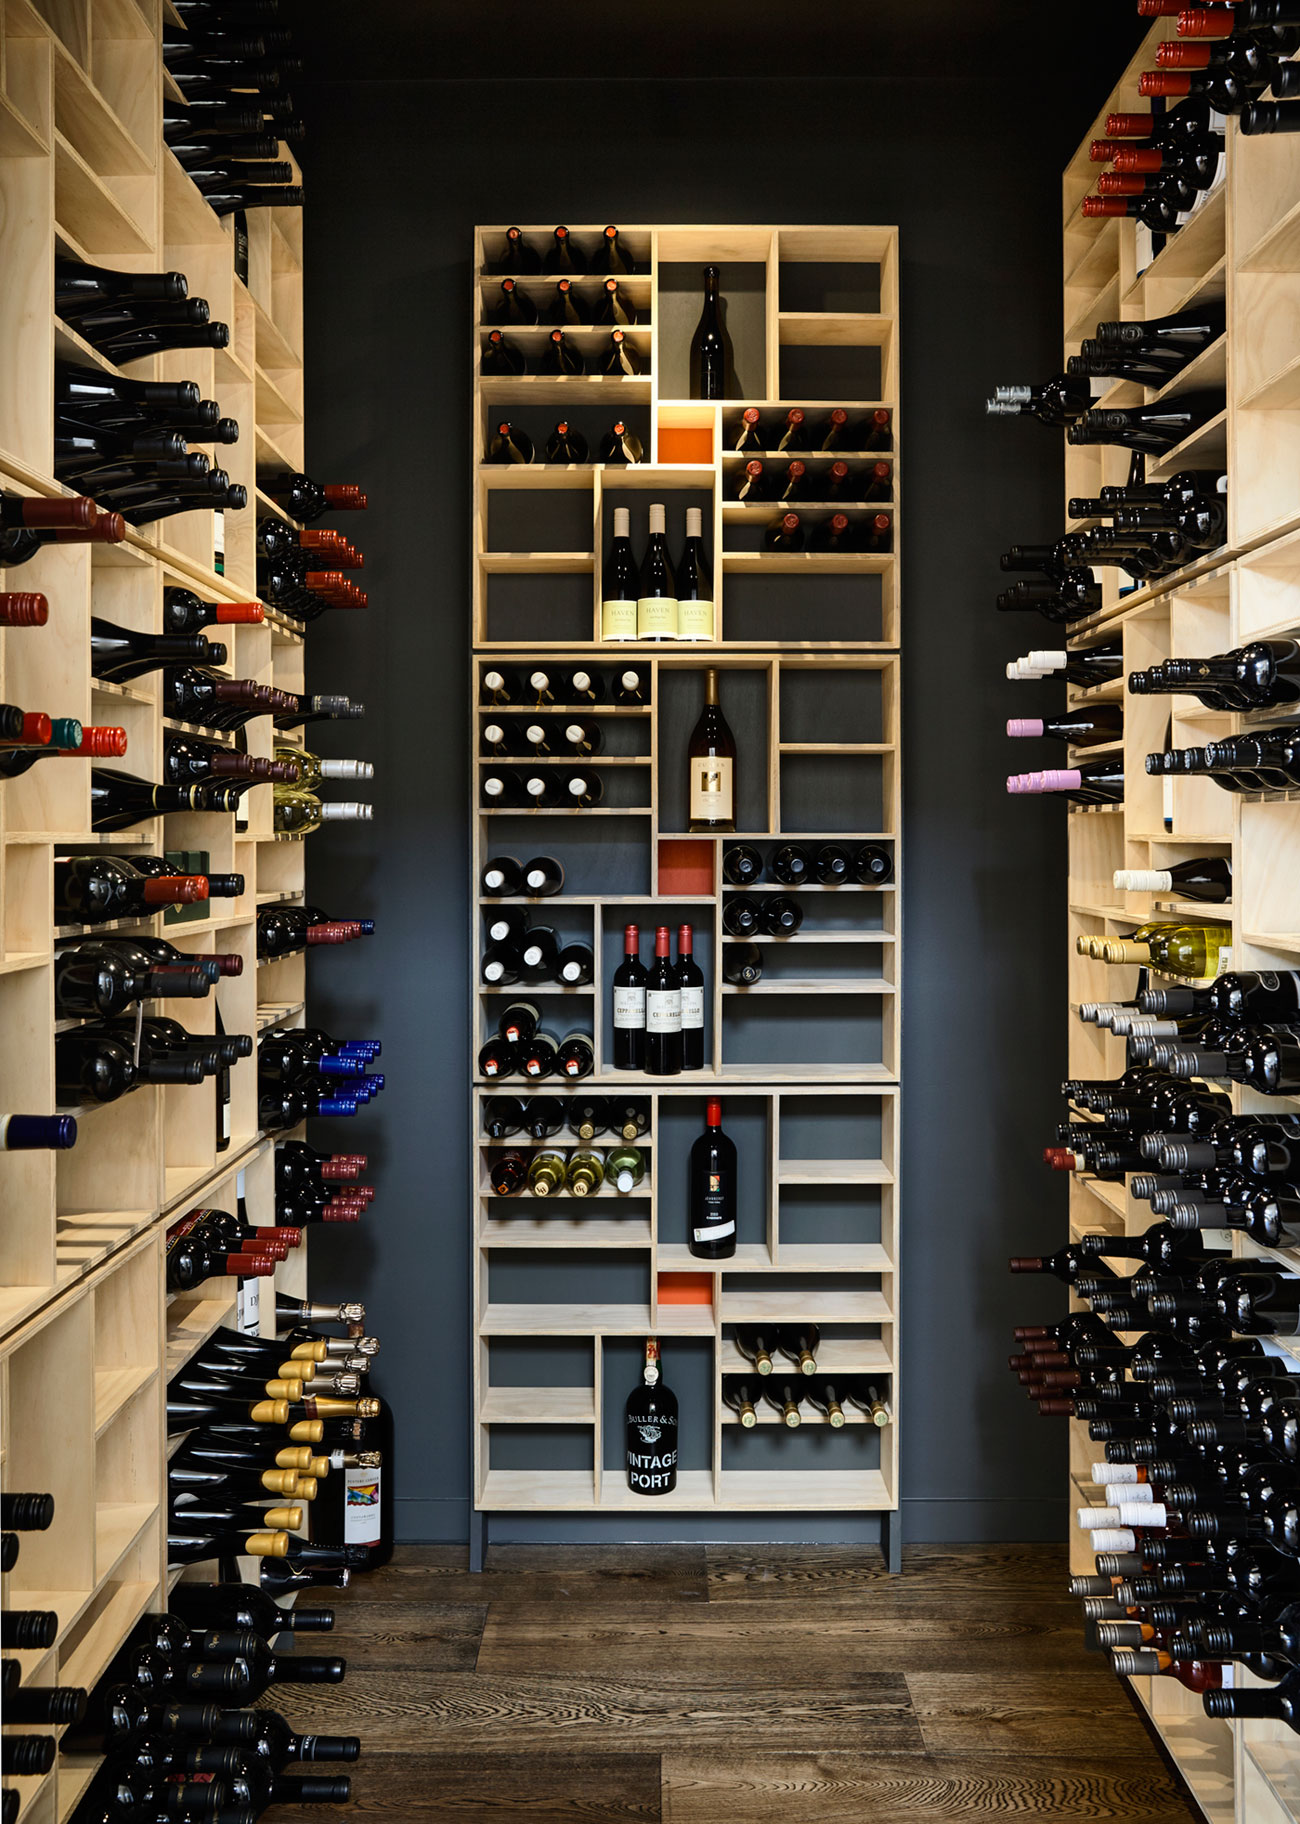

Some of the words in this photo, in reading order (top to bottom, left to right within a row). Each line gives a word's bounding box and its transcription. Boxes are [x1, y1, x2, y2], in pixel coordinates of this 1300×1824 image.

[628, 1414, 659, 1423] BULLER
[659, 1415, 668, 1424] &
[627, 1449, 677, 1469] VINTAGE
[631, 1472, 671, 1488] PORT
